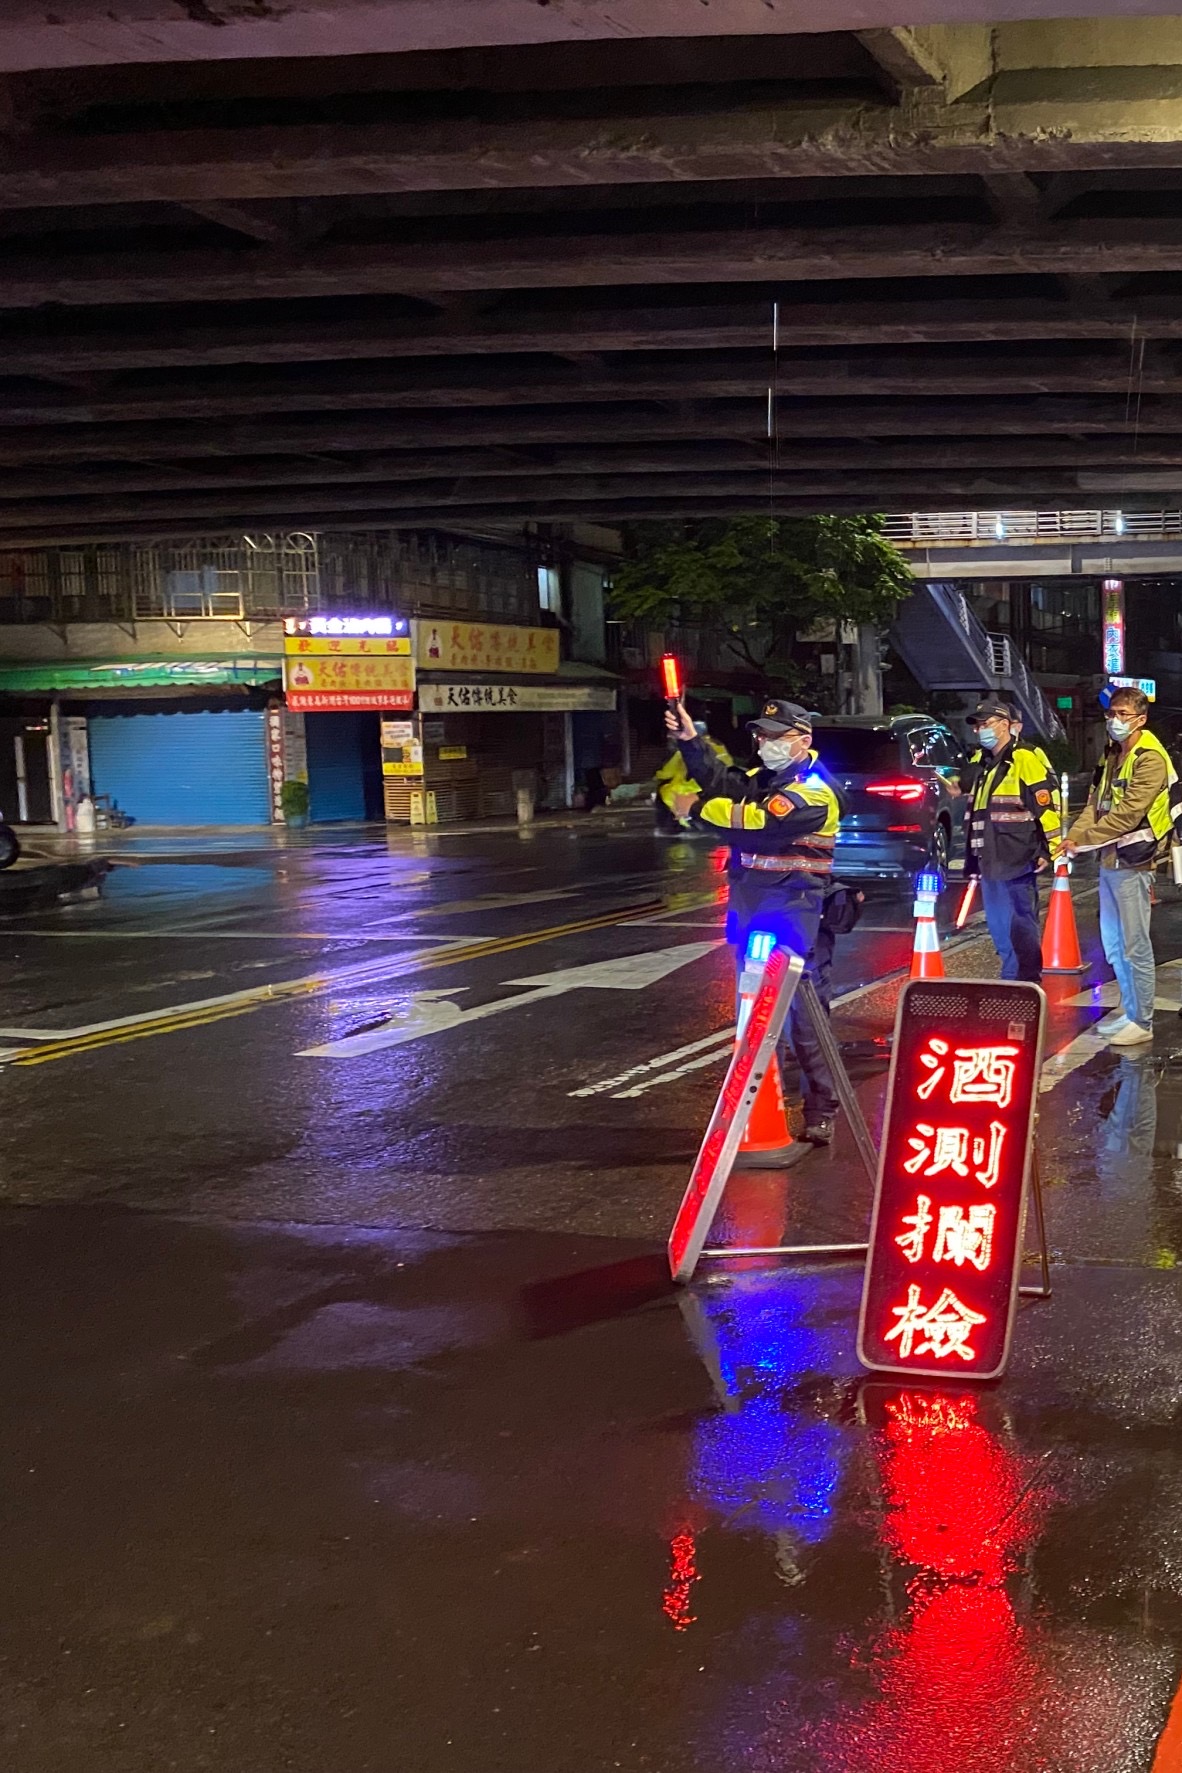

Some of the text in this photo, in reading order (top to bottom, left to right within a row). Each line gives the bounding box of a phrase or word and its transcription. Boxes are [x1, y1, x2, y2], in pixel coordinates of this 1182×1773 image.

[297, 639, 400, 653] 歡迎光臨
[446, 686, 518, 707] 天佑傳統美食
[884, 1038, 1020, 1361] 酒測攔檢
